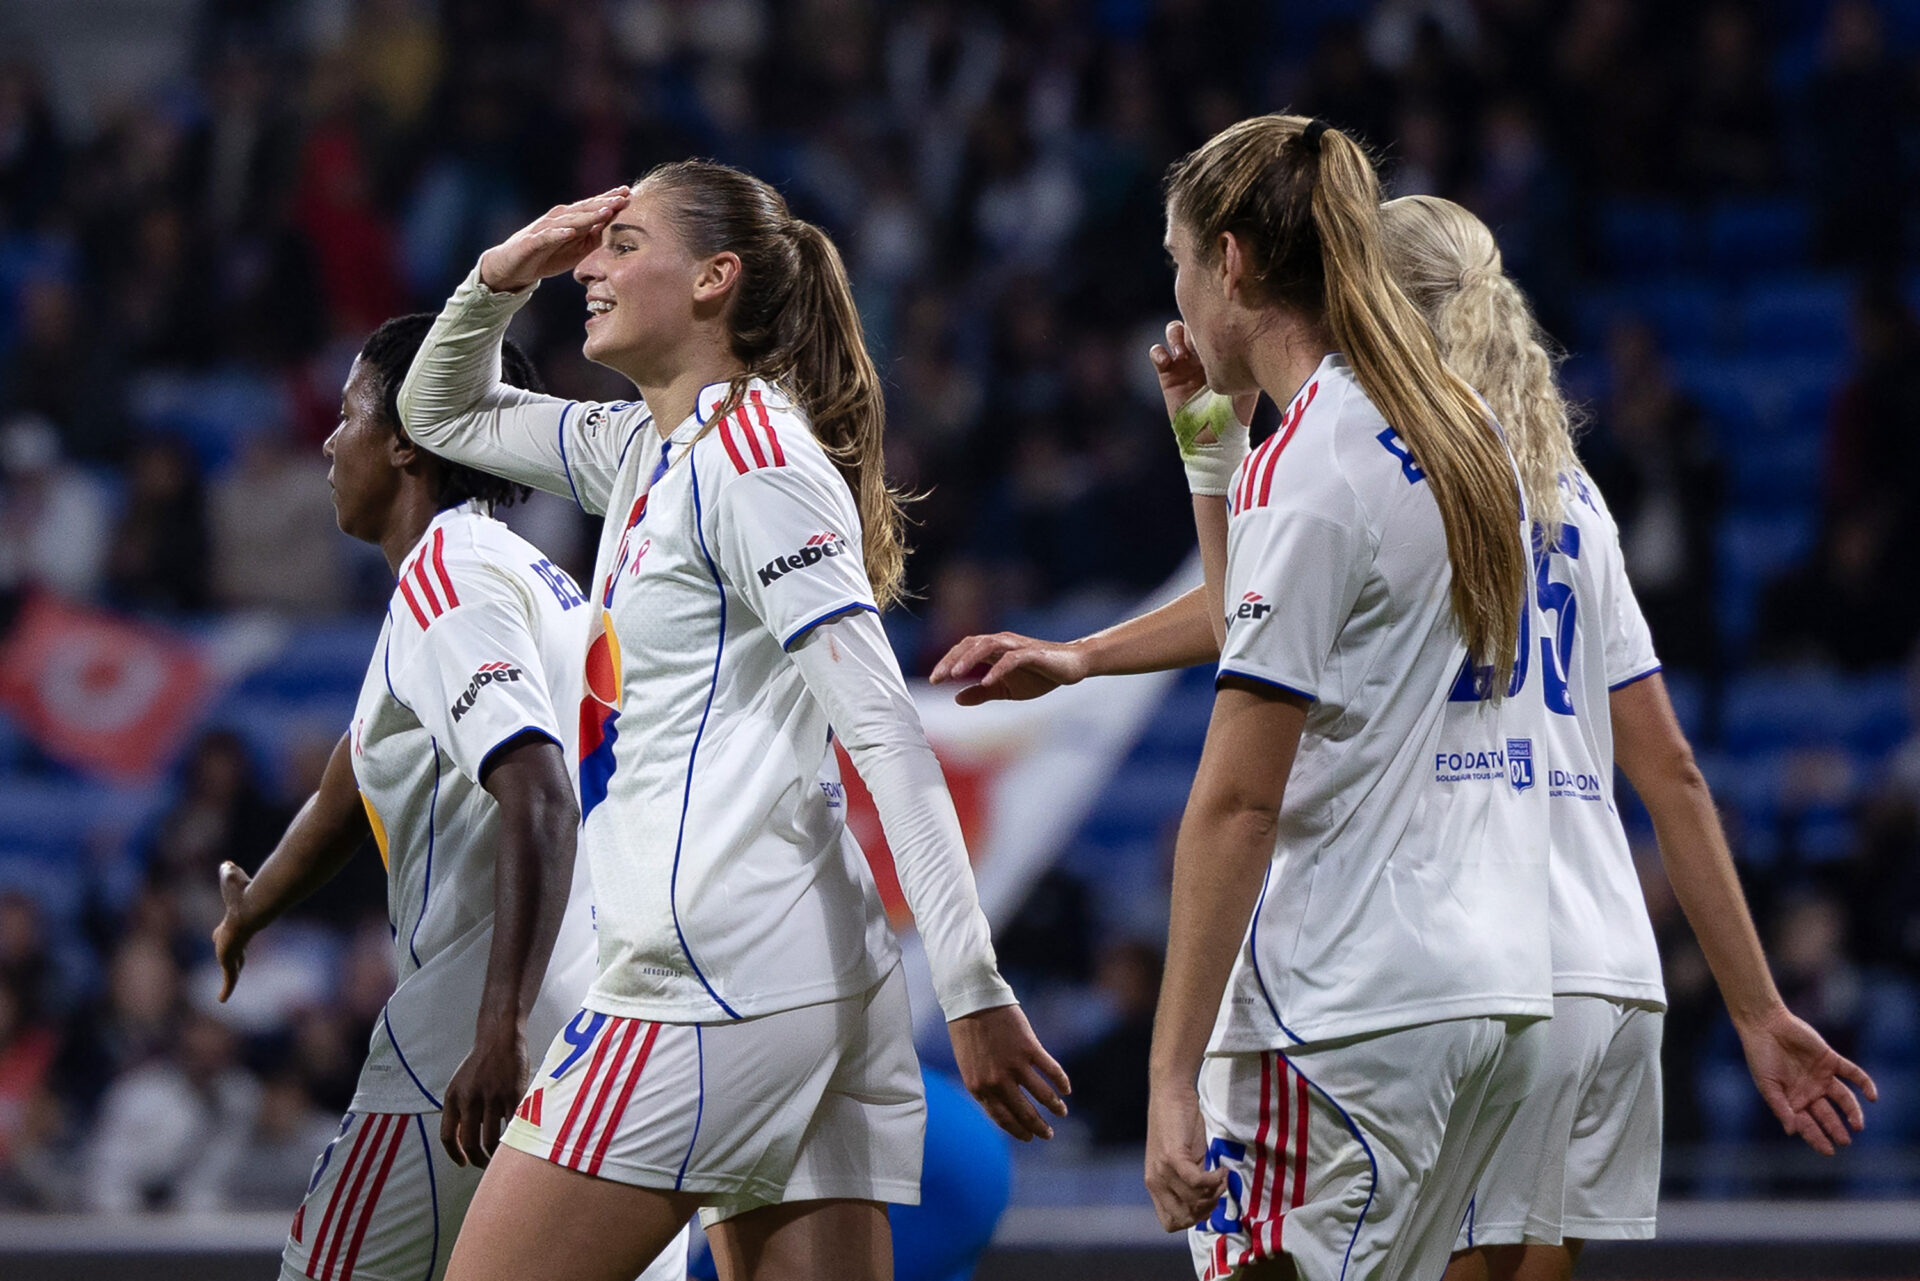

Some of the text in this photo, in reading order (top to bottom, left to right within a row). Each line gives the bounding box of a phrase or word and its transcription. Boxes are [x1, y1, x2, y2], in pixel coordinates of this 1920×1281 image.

[757, 540, 846, 588] Kleber
[450, 668, 523, 723] Kleber
[1511, 760, 1531, 784] OL
[549, 1008, 608, 1080] 9
